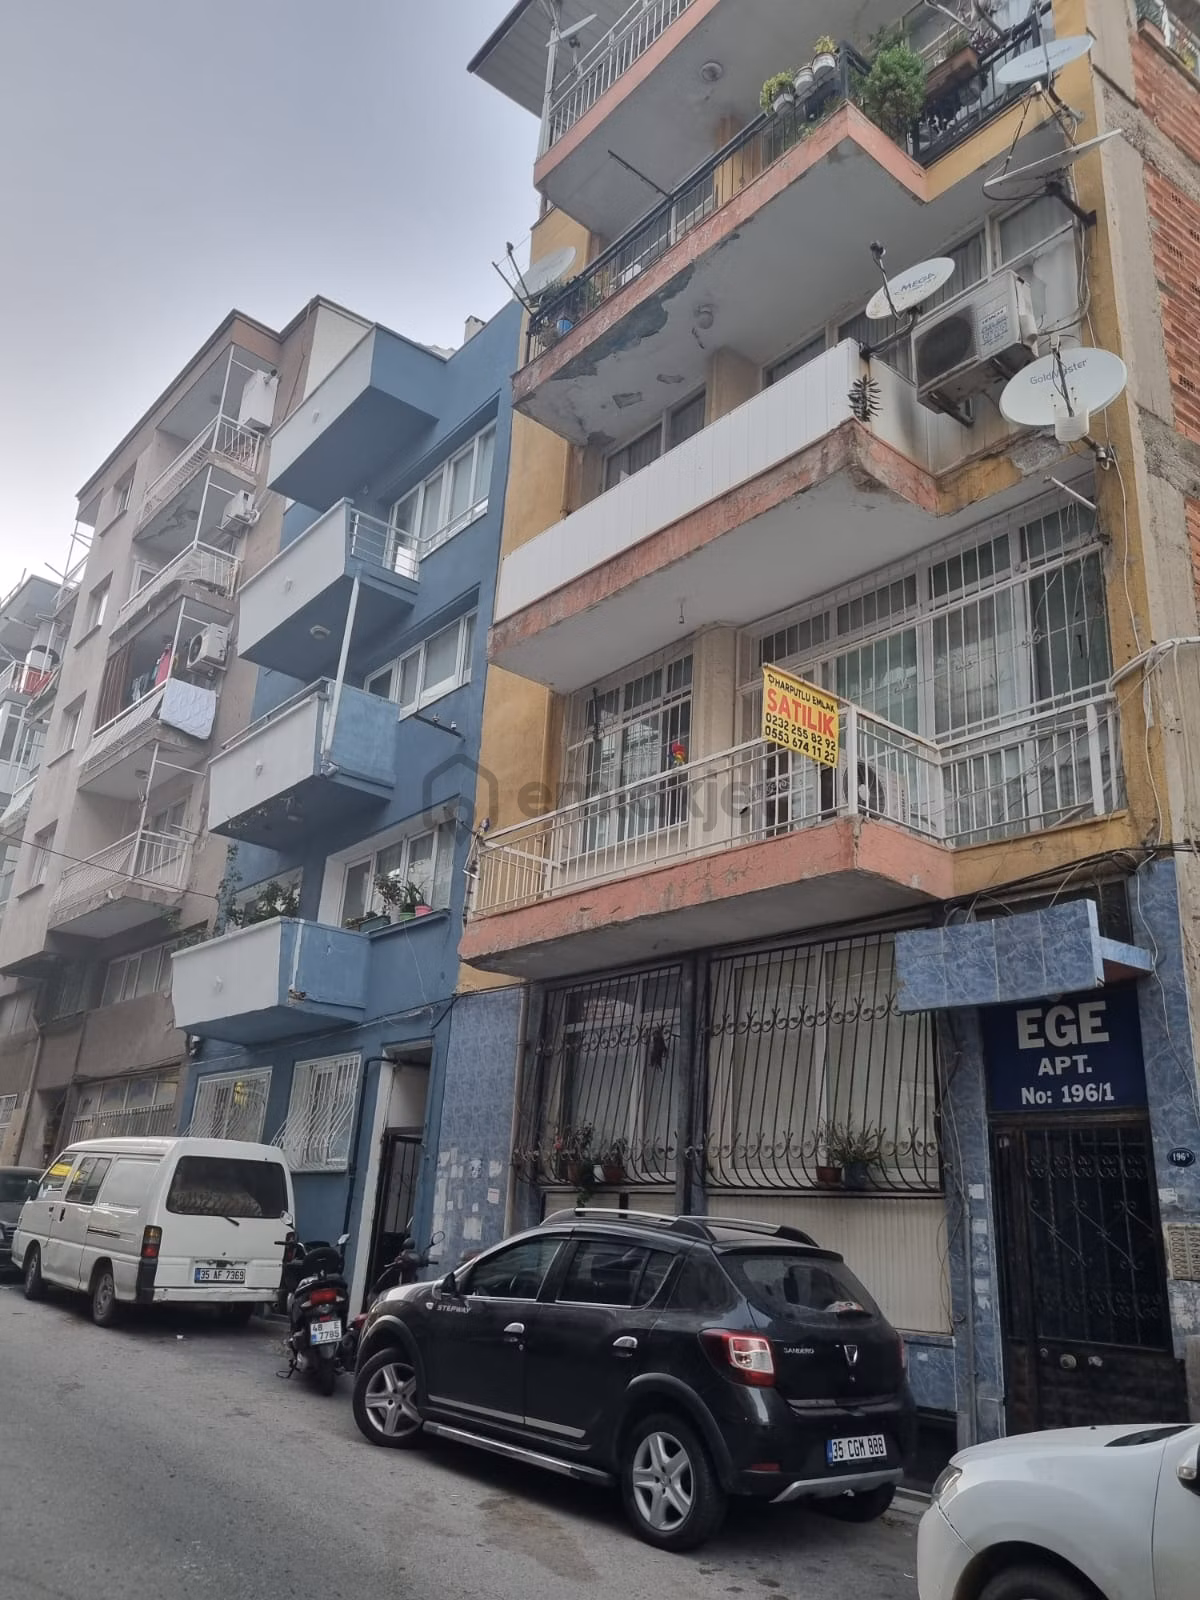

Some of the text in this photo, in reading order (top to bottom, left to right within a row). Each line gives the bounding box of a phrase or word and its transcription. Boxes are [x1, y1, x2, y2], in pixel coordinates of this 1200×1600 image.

[767, 688, 835, 738] SATILIK
[774, 678, 835, 713] HARPUTLU EMLAK
[765, 725, 835, 763] 0553 674 11 23
[766, 712, 836, 751] 0232 255 82 92
[1016, 1000, 1110, 1049] EGE
[1037, 1054, 1093, 1076] APT.
[1021, 1082, 1115, 1105] No: 196/1
[200, 1270, 244, 1280] 35 AF 7369
[832, 1437, 884, 1460] 35 CGM 888
